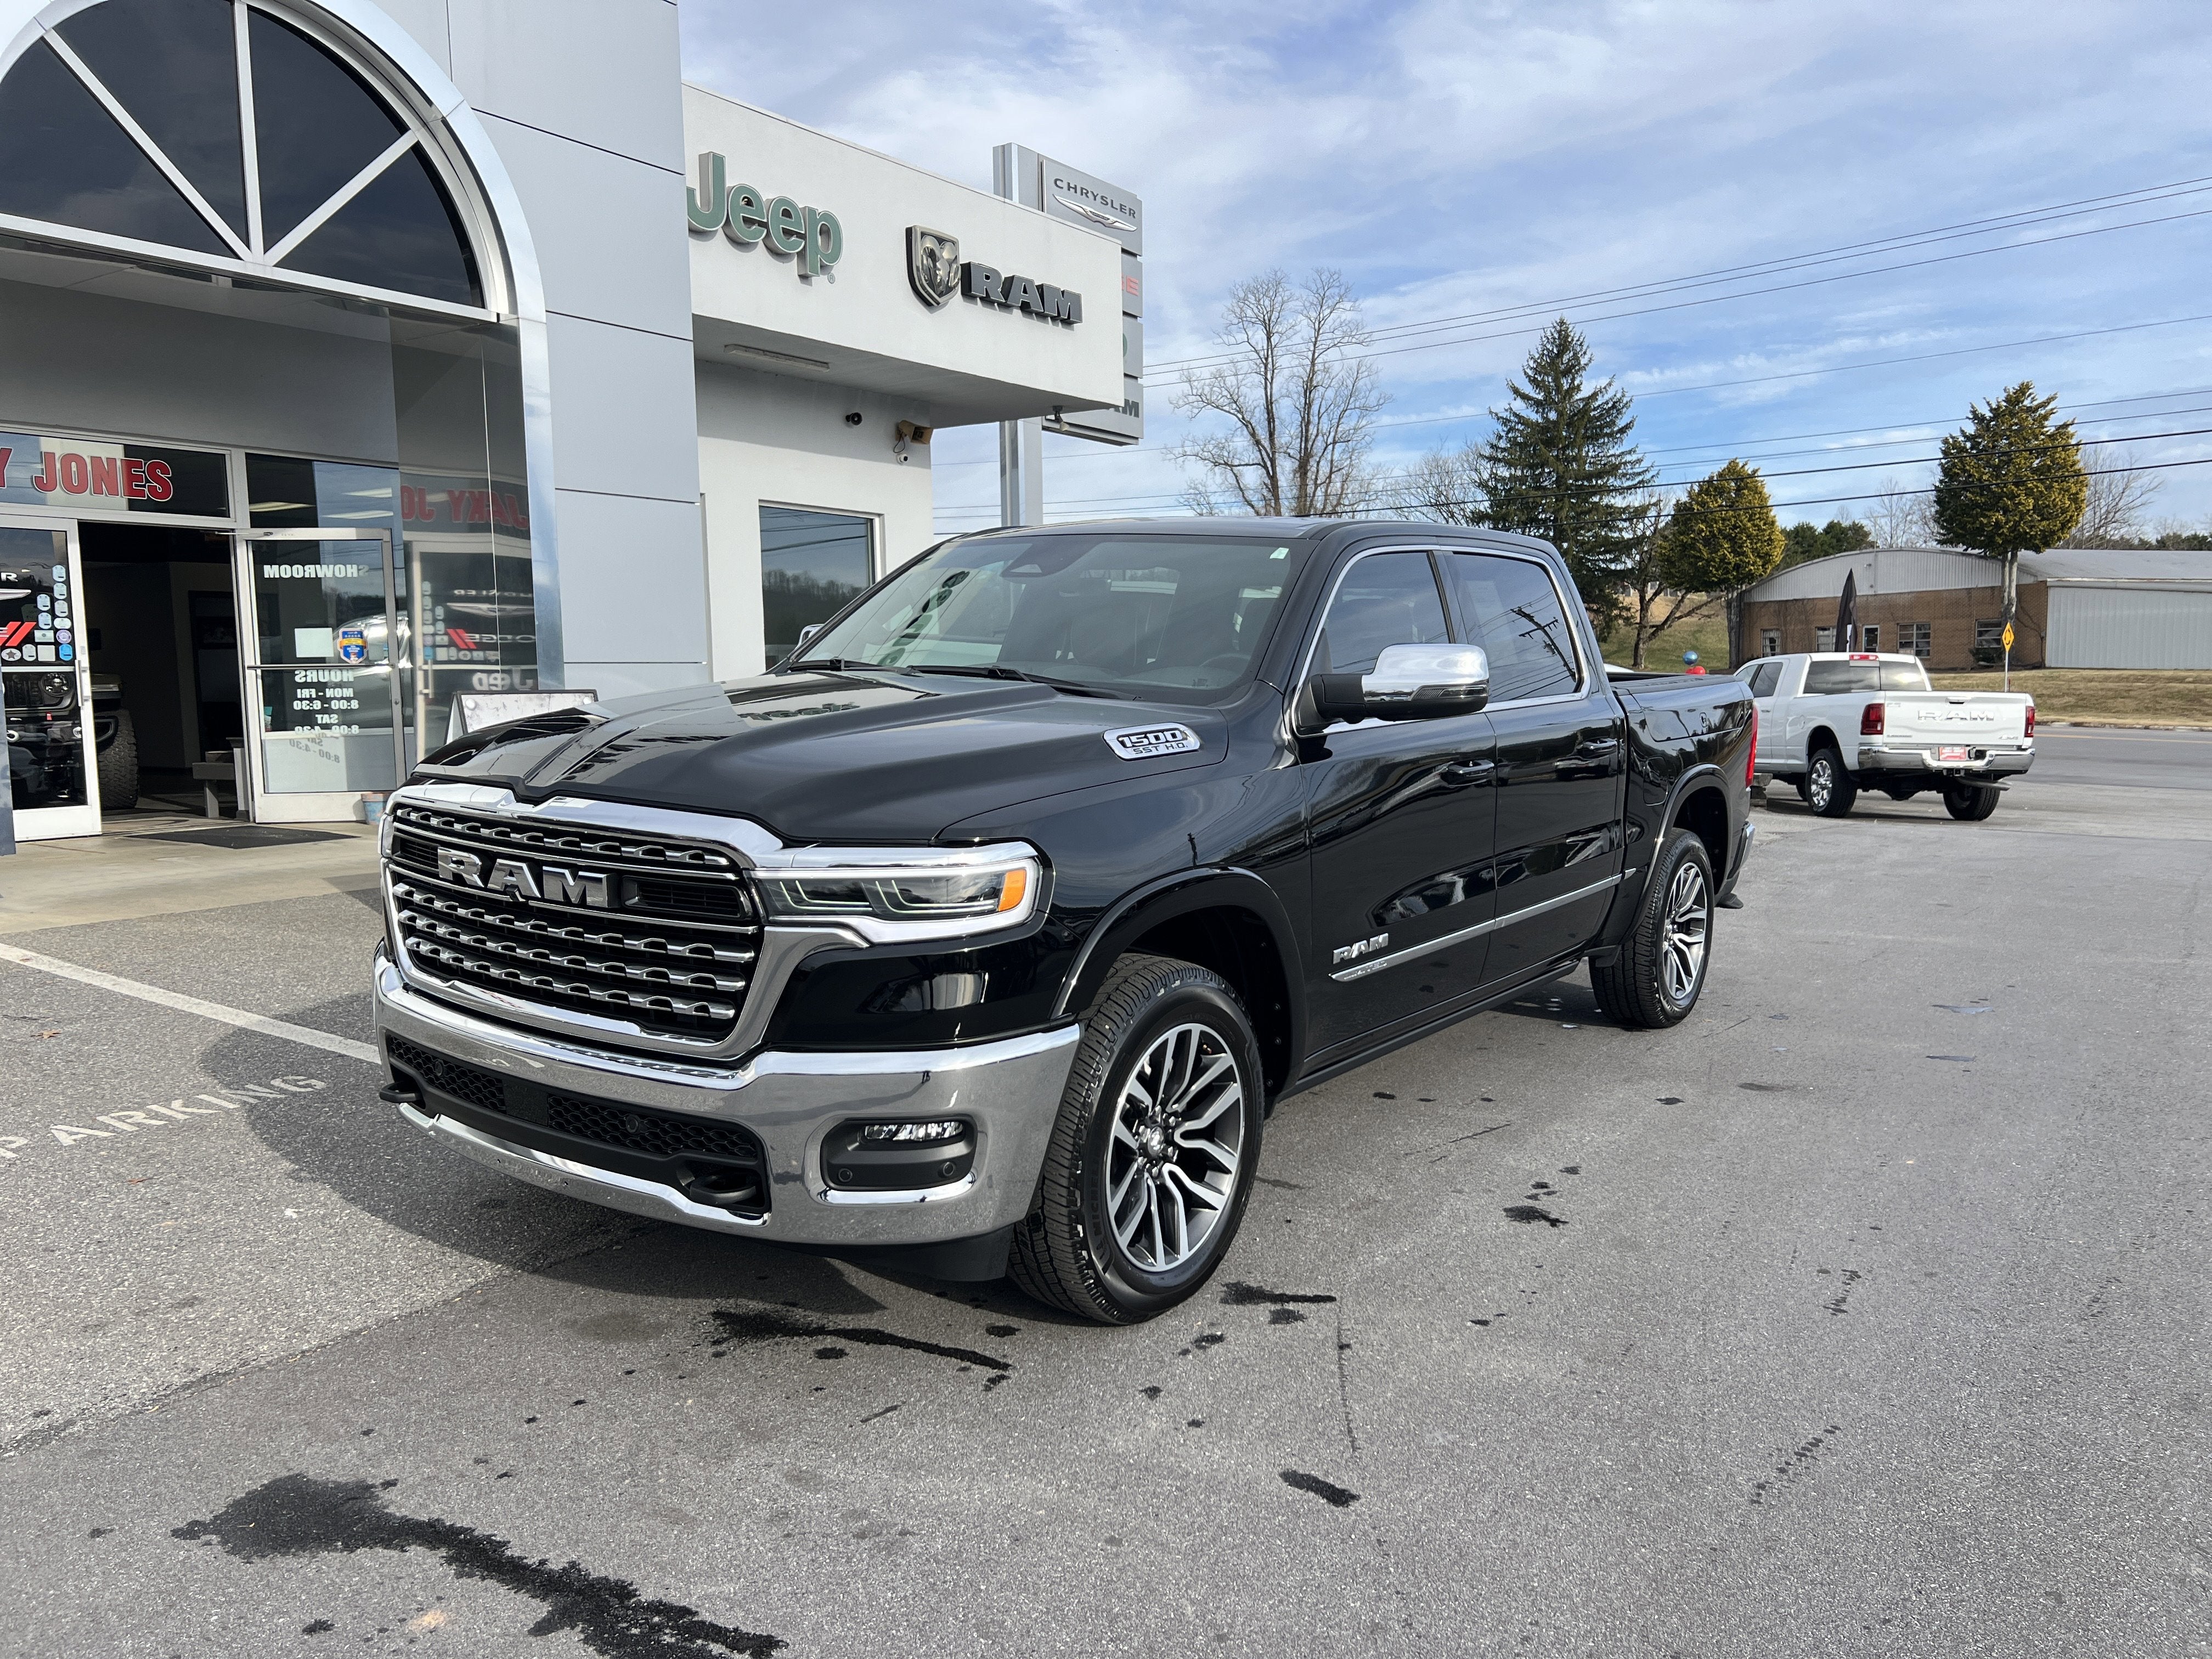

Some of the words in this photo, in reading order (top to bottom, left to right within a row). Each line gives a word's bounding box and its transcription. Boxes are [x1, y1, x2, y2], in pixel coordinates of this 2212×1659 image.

[686, 151, 843, 276] Jeep
[1053, 178, 1136, 218] CHRYSLER
[963, 262, 1083, 324] RAM
[32, 451, 173, 501] JONES
[1918, 710, 1994, 721] RAM
[1118, 730, 1183, 748] 1500
[1133, 746, 1160, 754] SST
[1165, 741, 1188, 751] H.O.
[438, 847, 619, 908] RAM
[1332, 933, 1389, 964] RAM
